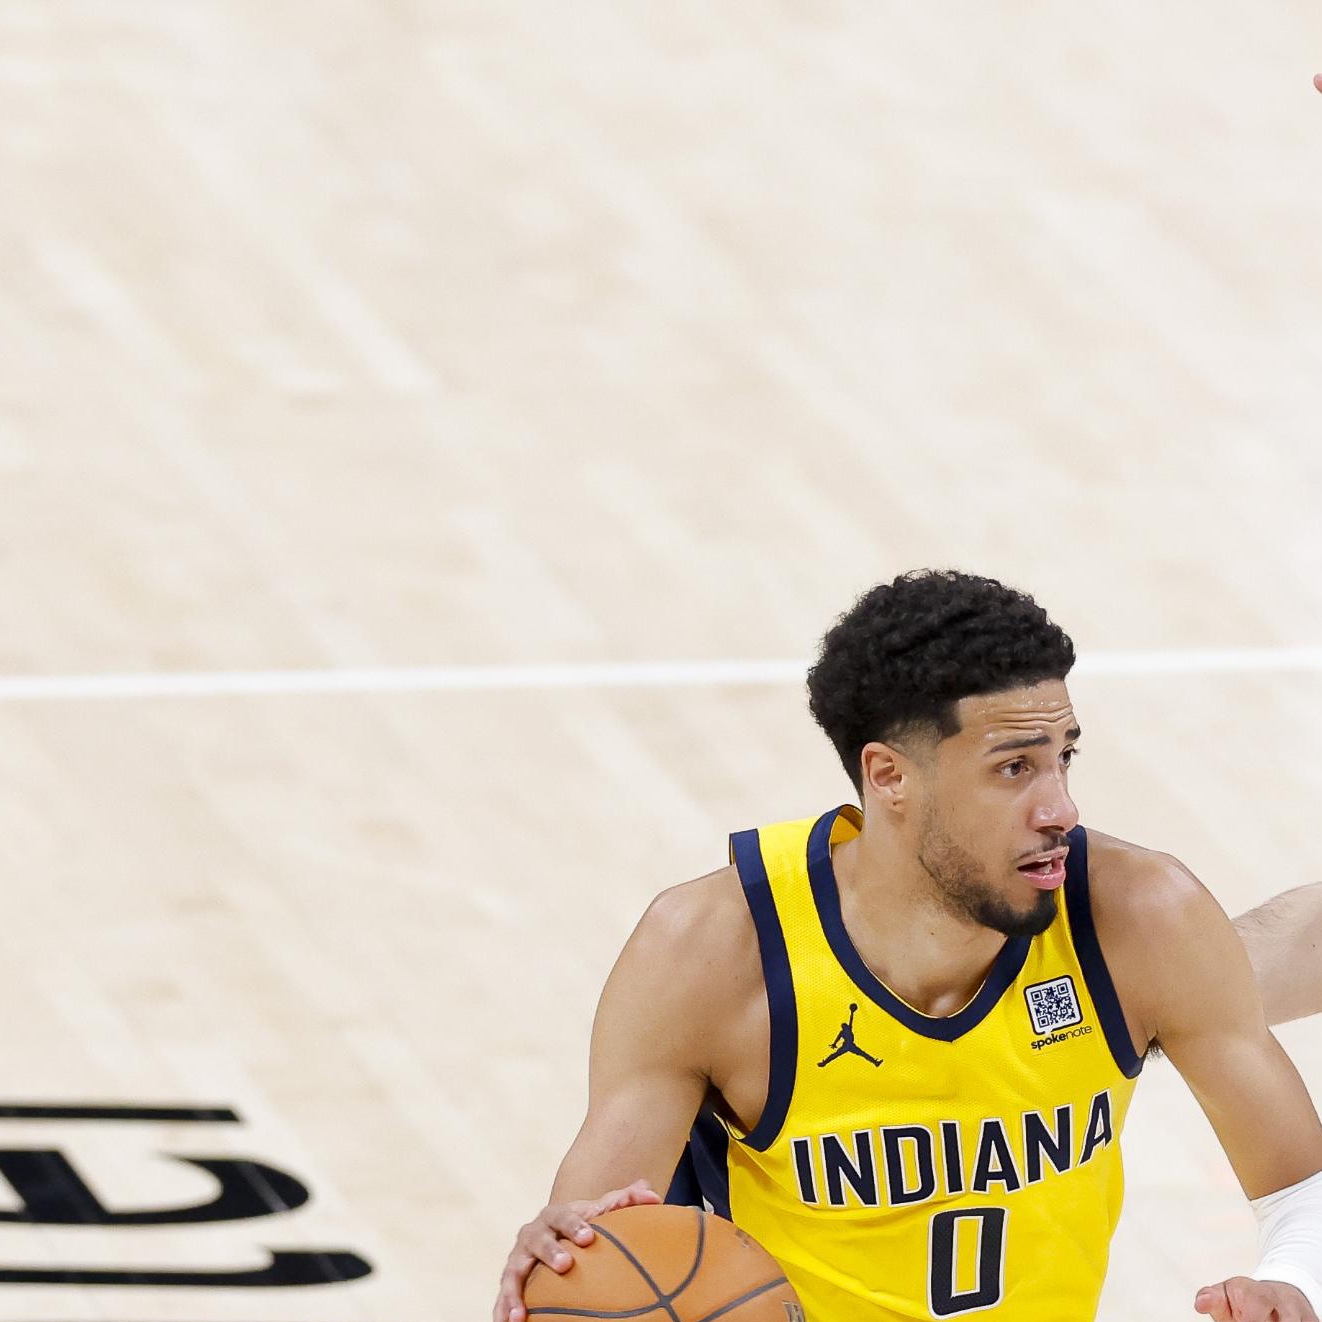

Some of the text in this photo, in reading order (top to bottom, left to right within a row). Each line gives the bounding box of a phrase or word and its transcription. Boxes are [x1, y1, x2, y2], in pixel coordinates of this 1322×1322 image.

[1030, 1025, 1093, 1051] spokenote
[791, 1089, 1115, 1207] INDIANA
[927, 1205, 1010, 1320] 0
